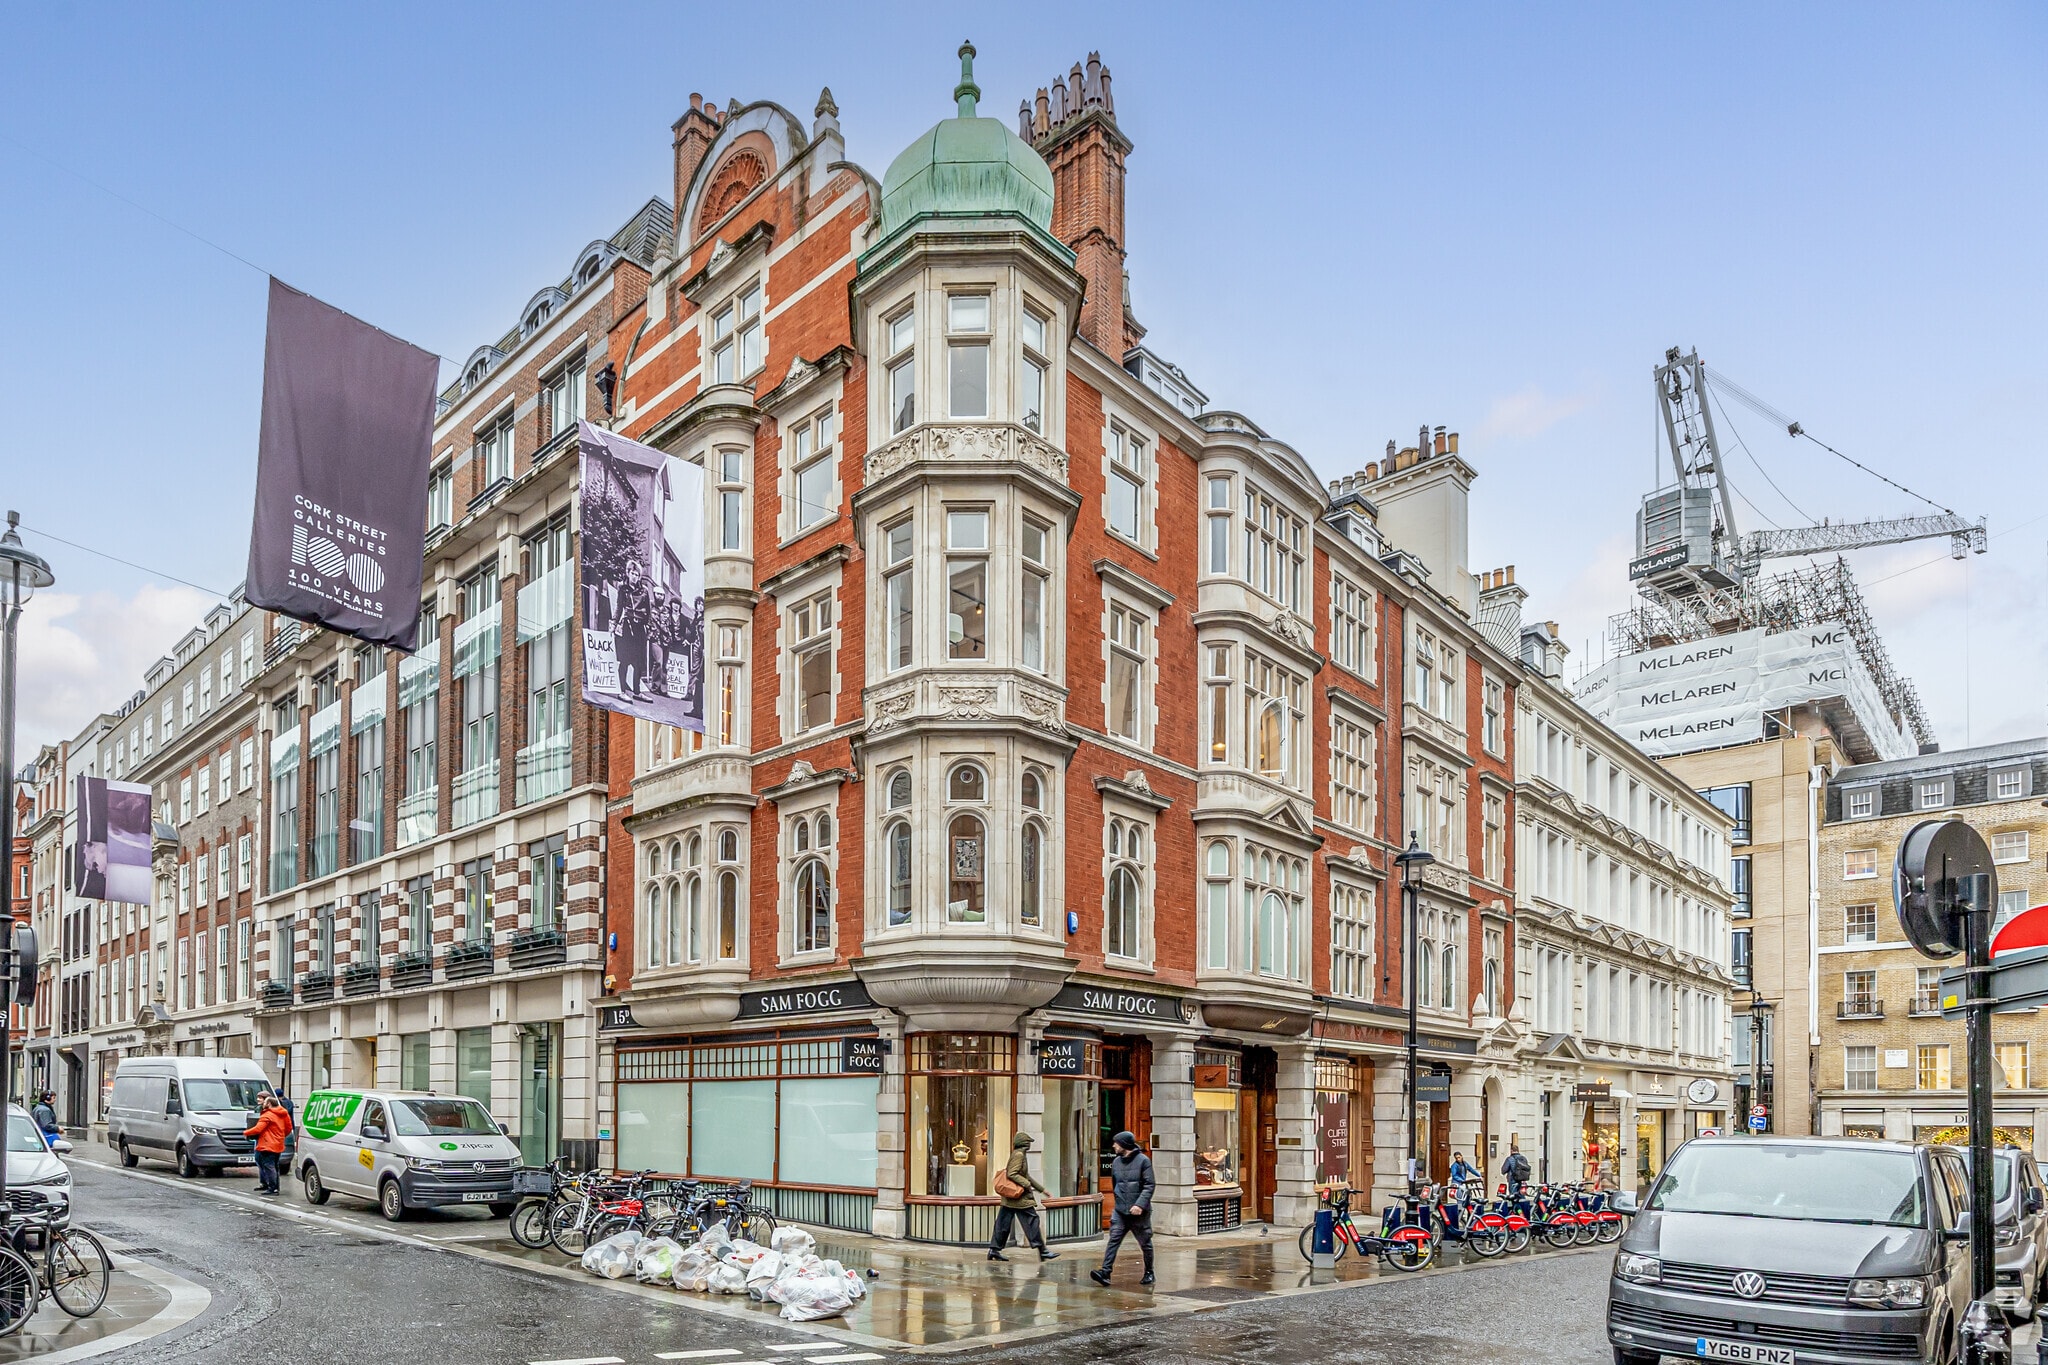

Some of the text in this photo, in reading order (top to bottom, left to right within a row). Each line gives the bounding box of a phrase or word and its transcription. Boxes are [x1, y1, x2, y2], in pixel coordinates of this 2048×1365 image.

[294, 494, 387, 541] CORK STREET
[294, 509, 386, 556] GALLERIES
[1630, 552, 1686, 574] McLAREN
[288, 568, 384, 612] 100 YEARS
[297, 584, 324, 598] INITIATIVE
[587, 633, 614, 652] BLACK
[588, 658, 615, 674] WHITE
[1639, 645, 1734, 672] McLAREN
[592, 675, 616, 686] UNITE
[1641, 682, 1736, 707] McLAREN
[1640, 717, 1734, 742] McLAREN
[760, 989, 842, 1014] SAM FOGG
[1082, 991, 1156, 1015] SAM FOGG
[853, 1042, 876, 1055] SAM
[1046, 1046, 1072, 1056] SAM
[850, 1056, 880, 1068] FOGG
[1042, 1058, 1076, 1070] FOGG
[307, 1096, 353, 1127] zipcar
[1708, 1342, 1790, 1364] YG68 PNZ
